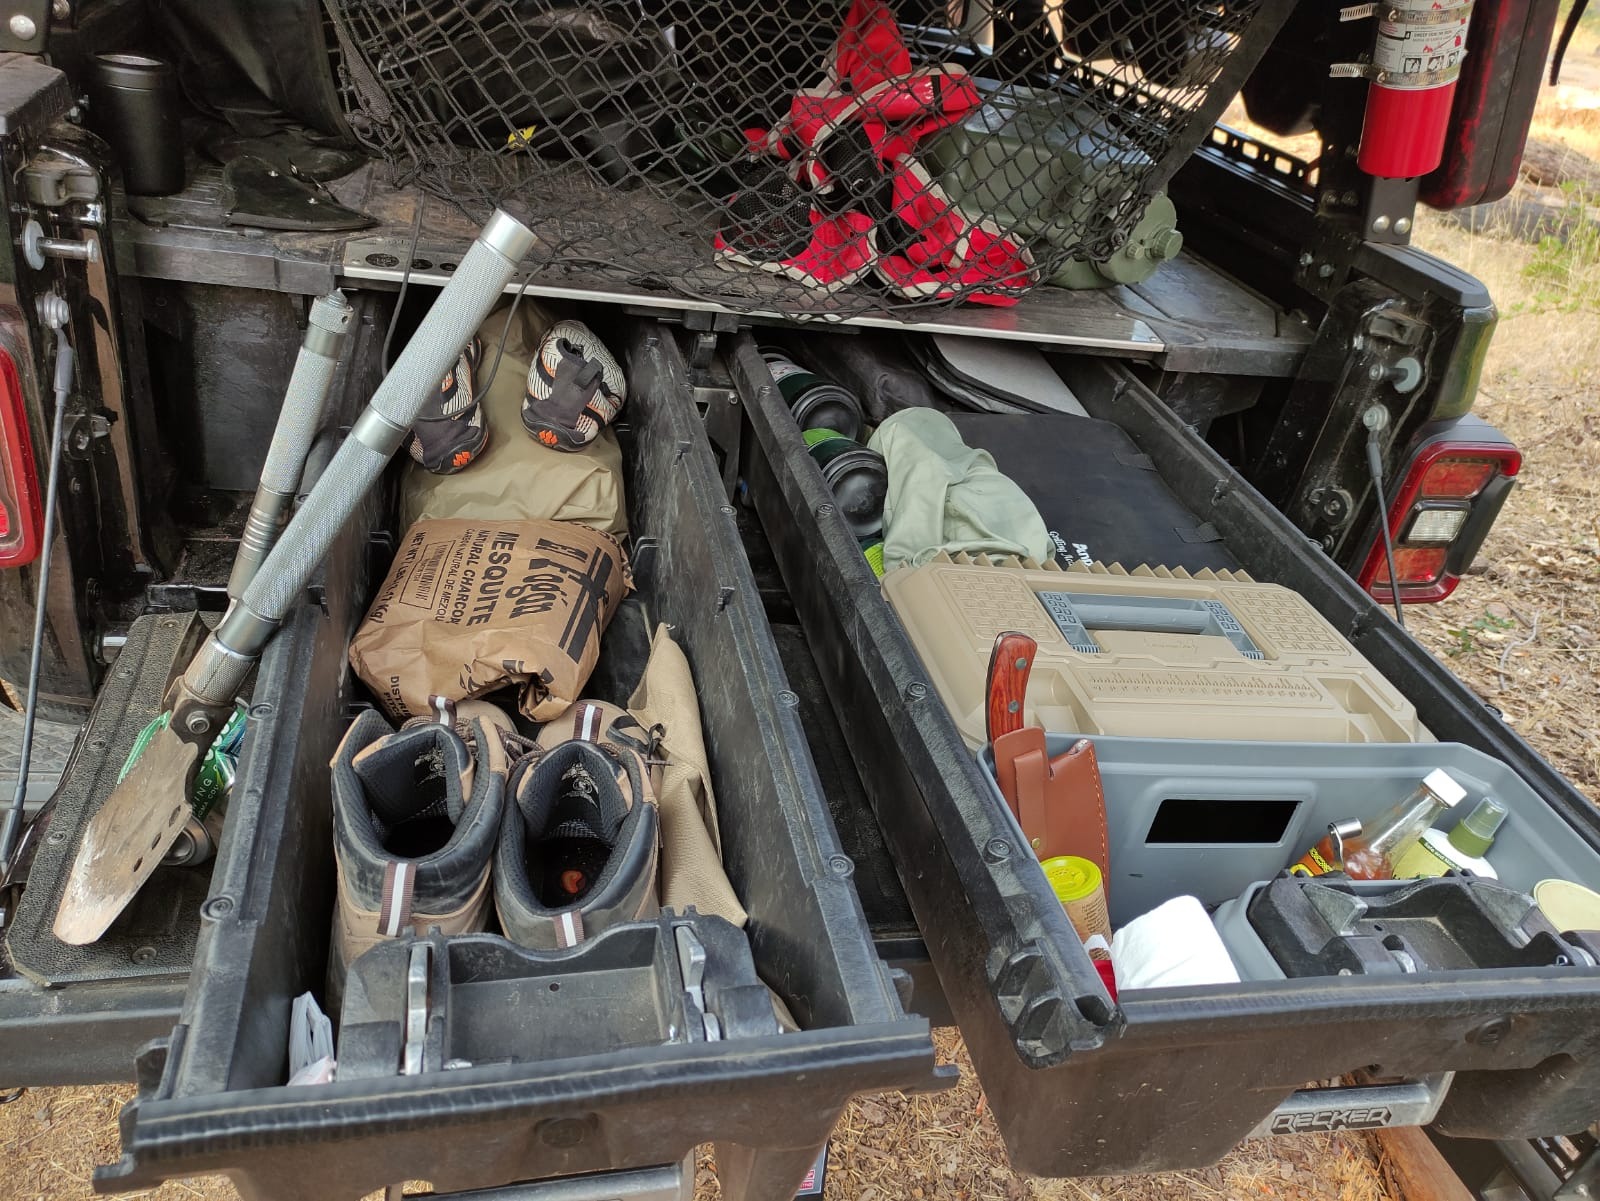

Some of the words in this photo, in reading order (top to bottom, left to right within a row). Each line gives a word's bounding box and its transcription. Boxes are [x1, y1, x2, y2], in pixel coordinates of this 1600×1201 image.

[411, 531, 426, 546] NET
[466, 529, 491, 566] NATURAL
[534, 538, 589, 564] El
[447, 547, 466, 577] NATURAL
[443, 578, 456, 591] DE
[466, 531, 520, 626] MESQUITE
[1271, 1107, 1392, 1134] DECKED
